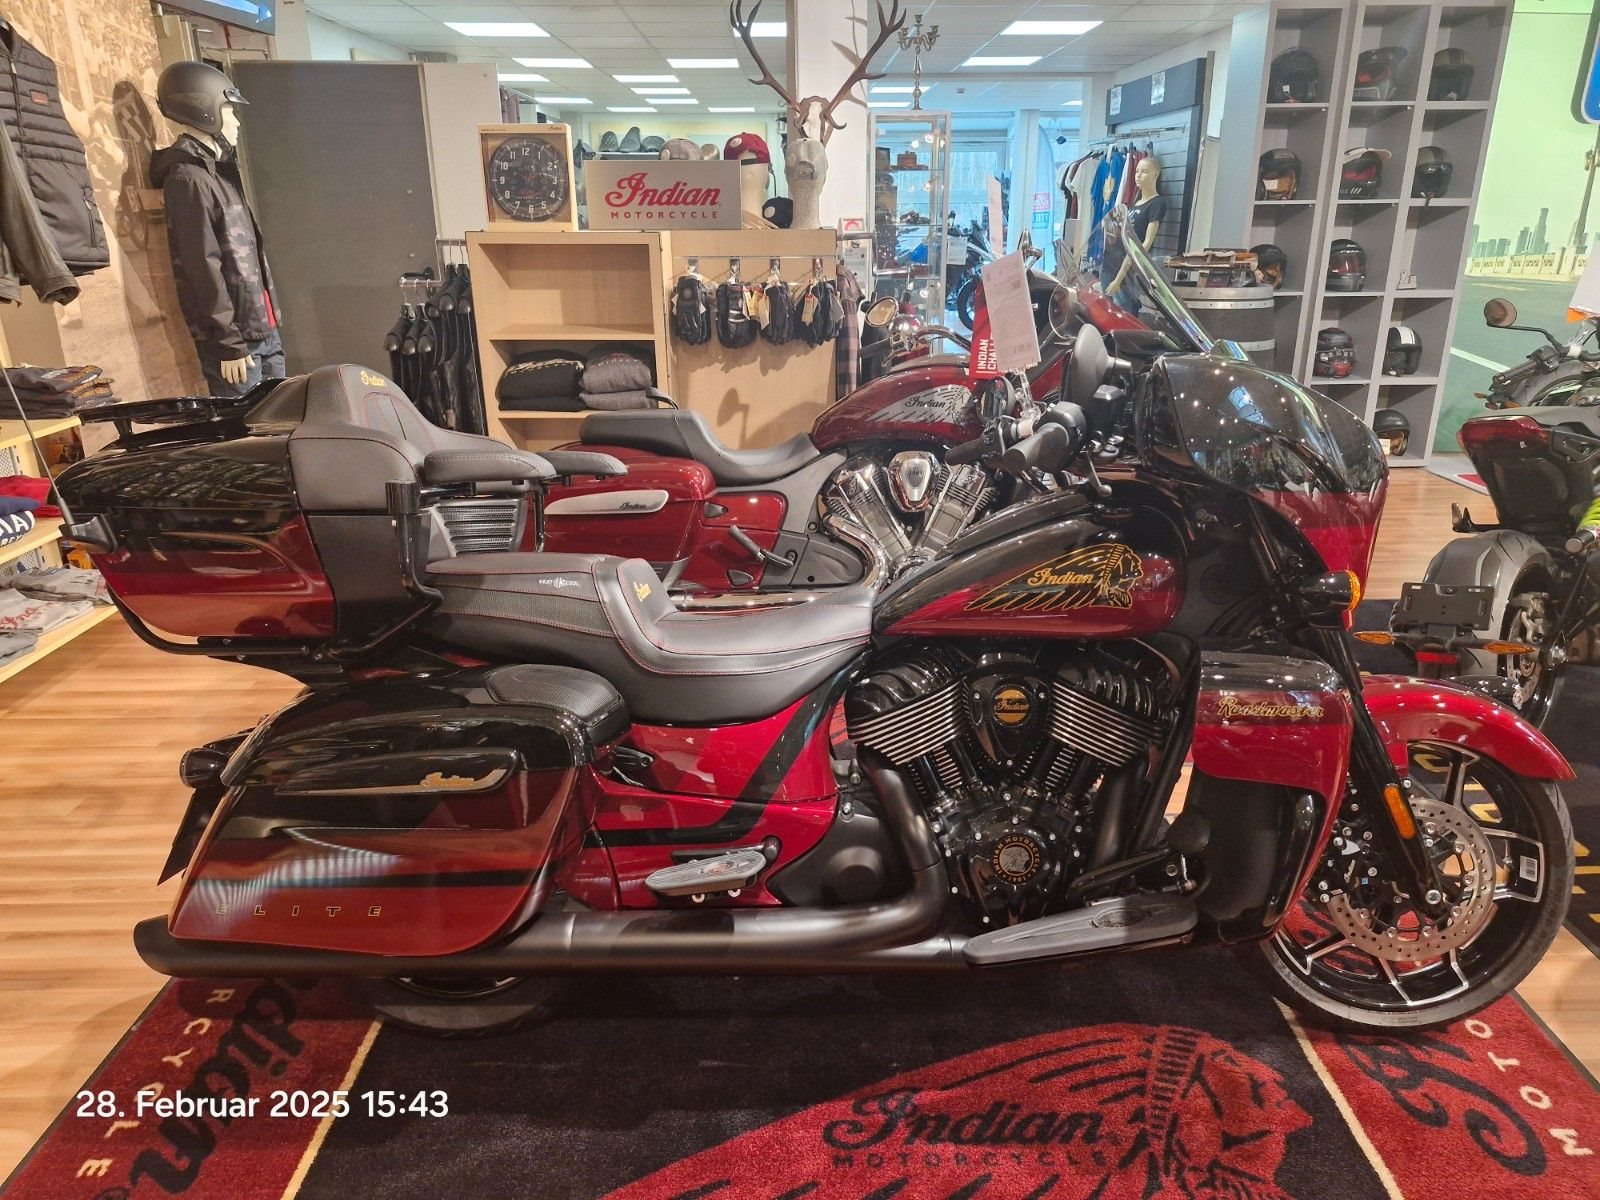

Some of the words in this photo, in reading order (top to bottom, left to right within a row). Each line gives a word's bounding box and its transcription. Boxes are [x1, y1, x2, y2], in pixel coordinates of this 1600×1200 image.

[510, 151, 516, 159] 11
[521, 147, 530, 156] 12
[537, 151, 541, 159] 1
[500, 162, 509, 170] 10
[547, 162, 553, 171] 2
[499, 176, 505, 185] 9
[504, 190, 510, 199] 8
[604, 172, 722, 208] Indian
[515, 201, 520, 209] 7
[528, 205, 534, 213] 6
[541, 201, 547, 209] 5
[610, 211, 719, 219] MOTORCYCLE
[977, 338, 989, 370] INDIAN
[904, 396, 946, 408] Indian
[1027, 567, 1095, 586] Indian
[994, 699, 1030, 711] Indian
[1217, 697, 1324, 717] Roadmaster
[216, 903, 382, 917] ELITE
[822, 1087, 1103, 1150] Indian
[832, 1151, 1106, 1168] MOTORCYCLE
